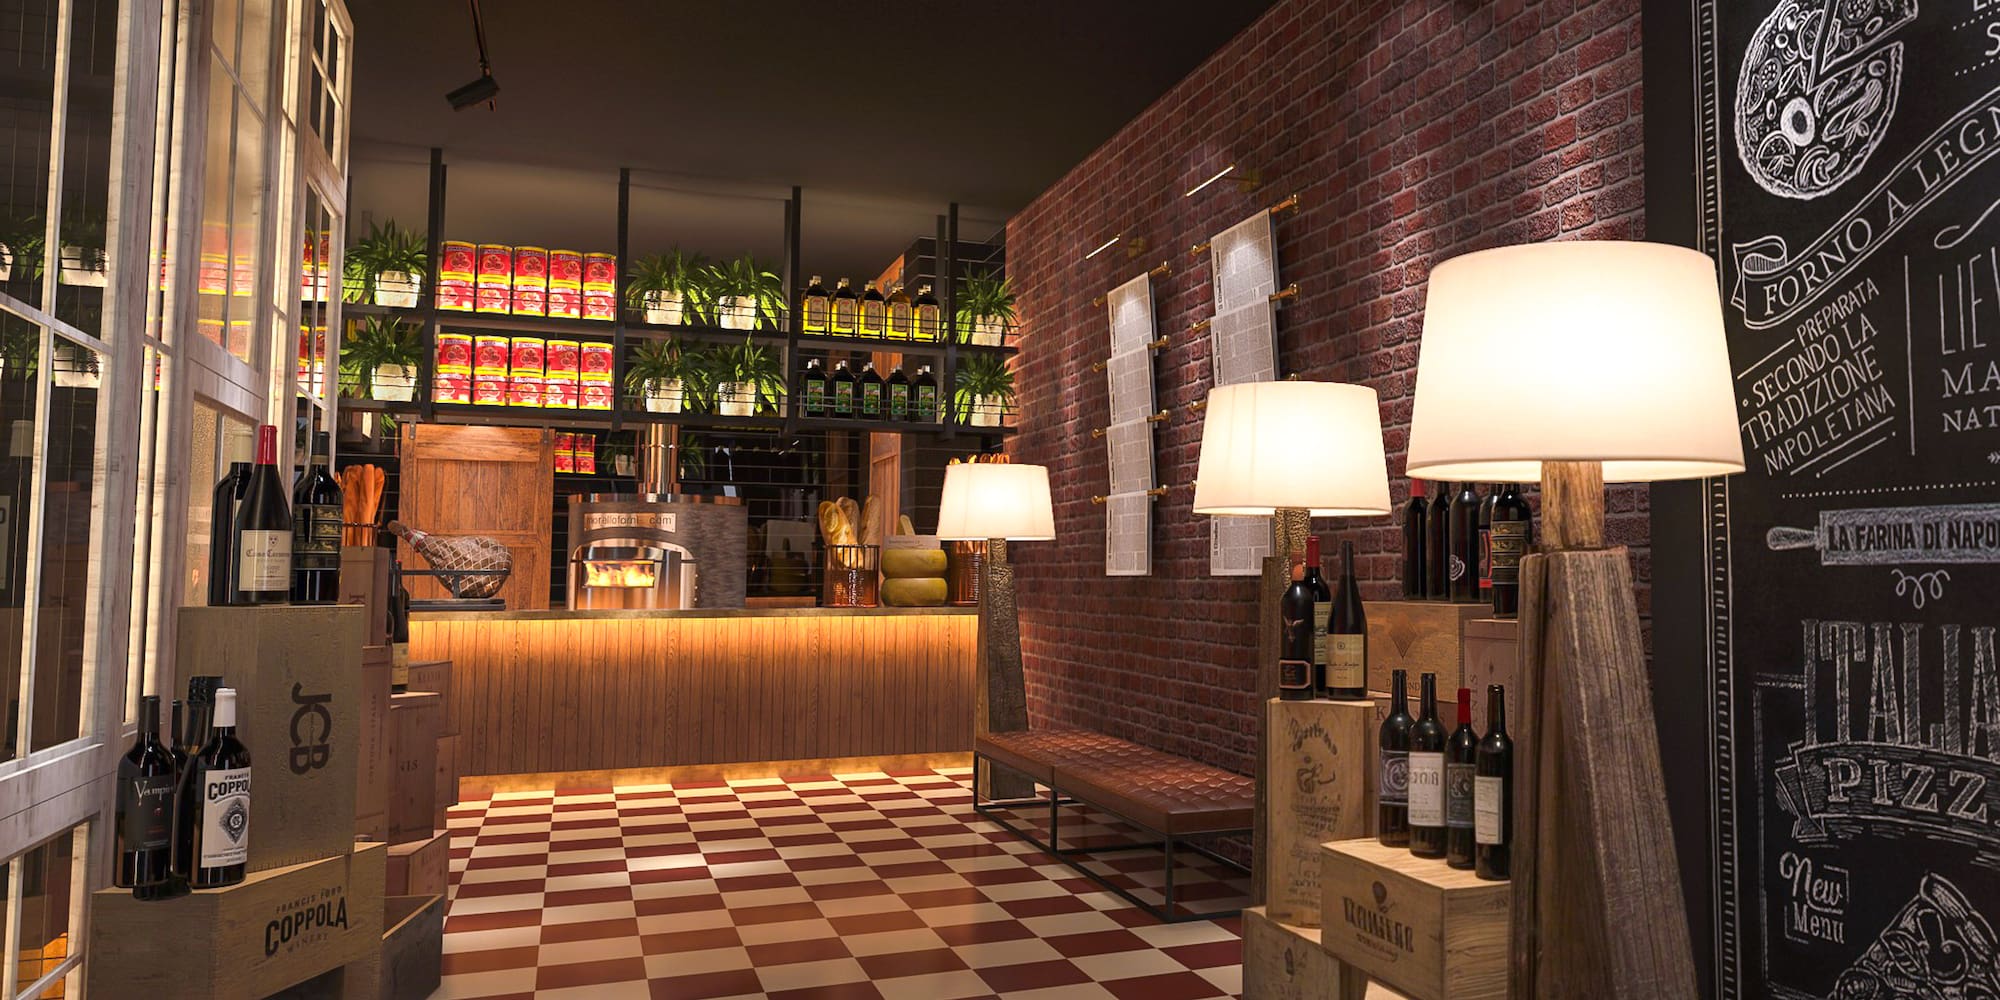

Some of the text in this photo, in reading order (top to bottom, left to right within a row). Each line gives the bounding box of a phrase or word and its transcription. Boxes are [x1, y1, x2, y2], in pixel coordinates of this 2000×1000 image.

[1763, 217, 1873, 316] FORNO
[1887, 189, 1910, 227] A
[1797, 278, 1879, 347] PREPARATA
[1754, 311, 1878, 409] SECONDO LA
[1742, 345, 1883, 449] TRADIZIONE
[1764, 384, 1896, 476] NAPOLETANA
[1943, 405, 2000, 433] NAT
[1828, 519, 2000, 551] LA FARINA DI NAPO
[289, 682, 332, 775] JCB
[1823, 758, 2000, 824] PIZZ
[275, 894, 317, 914] FRANCIS
[1780, 851, 1843, 910] New
[264, 896, 349, 957] COPPOLA
[1793, 902, 1845, 944] Menu
